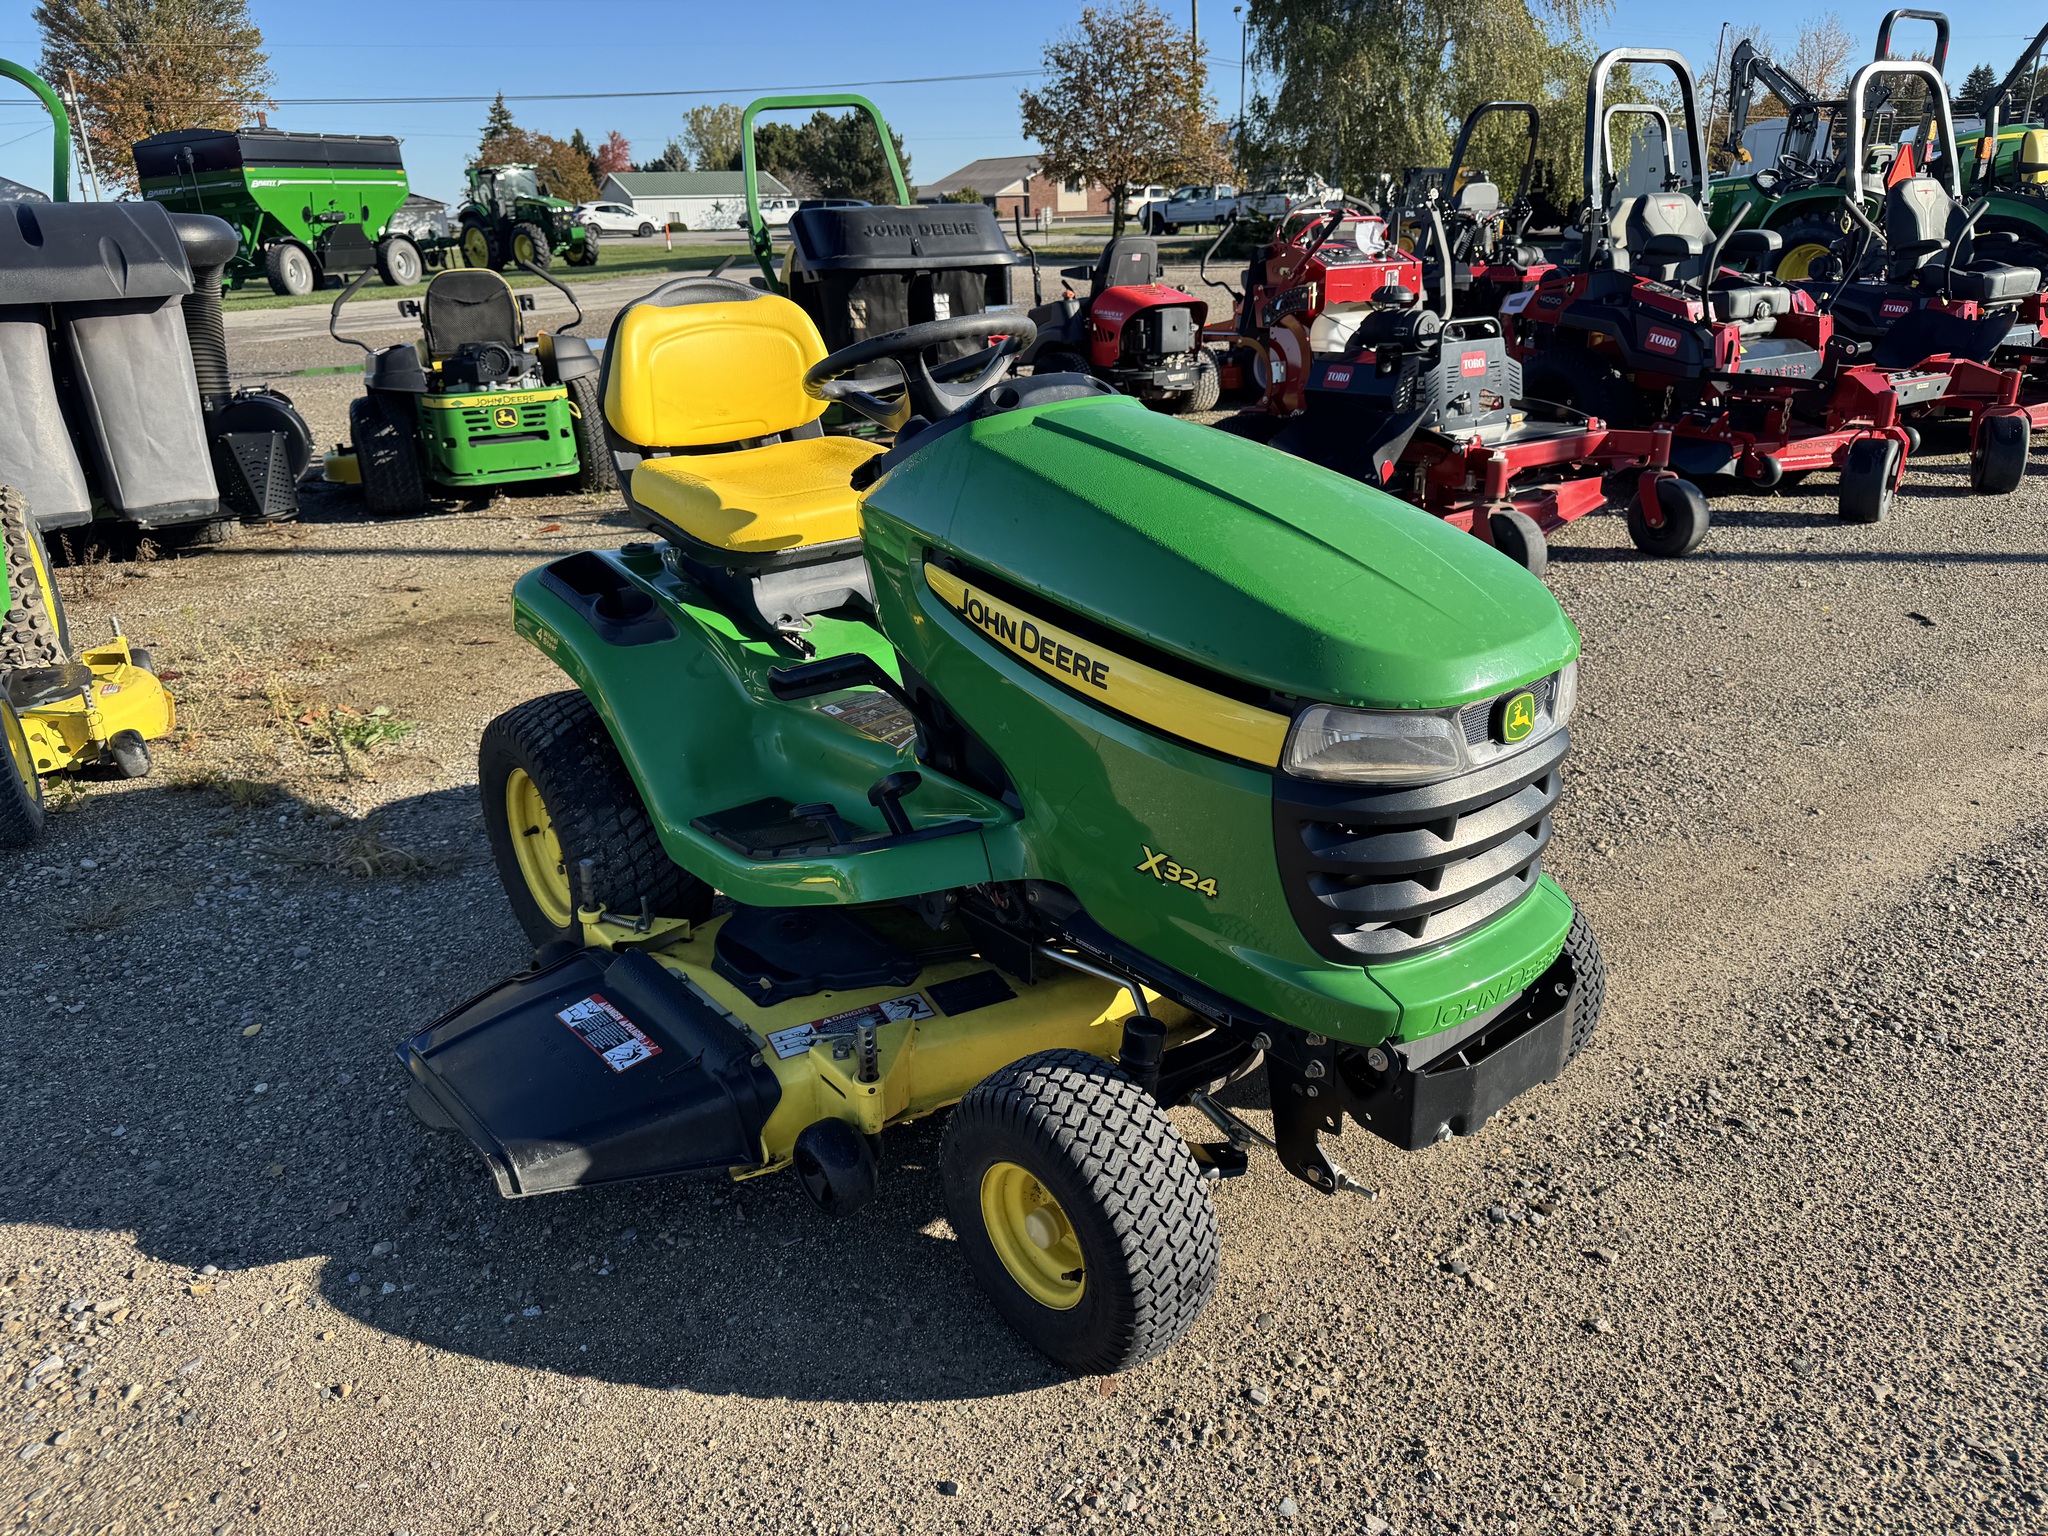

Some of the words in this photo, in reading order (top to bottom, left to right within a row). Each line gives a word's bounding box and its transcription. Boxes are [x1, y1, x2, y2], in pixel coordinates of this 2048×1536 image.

[863, 223, 913, 237] JOHN
[918, 222, 978, 236] DEERE
[1539, 295, 1562, 306] 4000
[1883, 304, 1909, 313] TORO
[1650, 332, 1677, 349] TORO
[1463, 358, 1485, 370] TORO
[1327, 371, 1349, 382] TORO
[475, 397, 502, 406] JOHN
[503, 395, 535, 404] DEERE
[1790, 442, 1812, 450] TURBO
[1814, 440, 1837, 448] FORCE
[536, 627, 543, 641] 4
[957, 588, 1017, 645] JOHN
[1020, 620, 1109, 690] DEERE
[1134, 843, 1219, 899] X324
[1417, 983, 1502, 1036] JOHN
[1503, 939, 1565, 998] DEERE
[832, 1006, 871, 1022] DANGER
[603, 1003, 624, 1020] DANGER
[626, 1022, 646, 1042] PELIGRO
